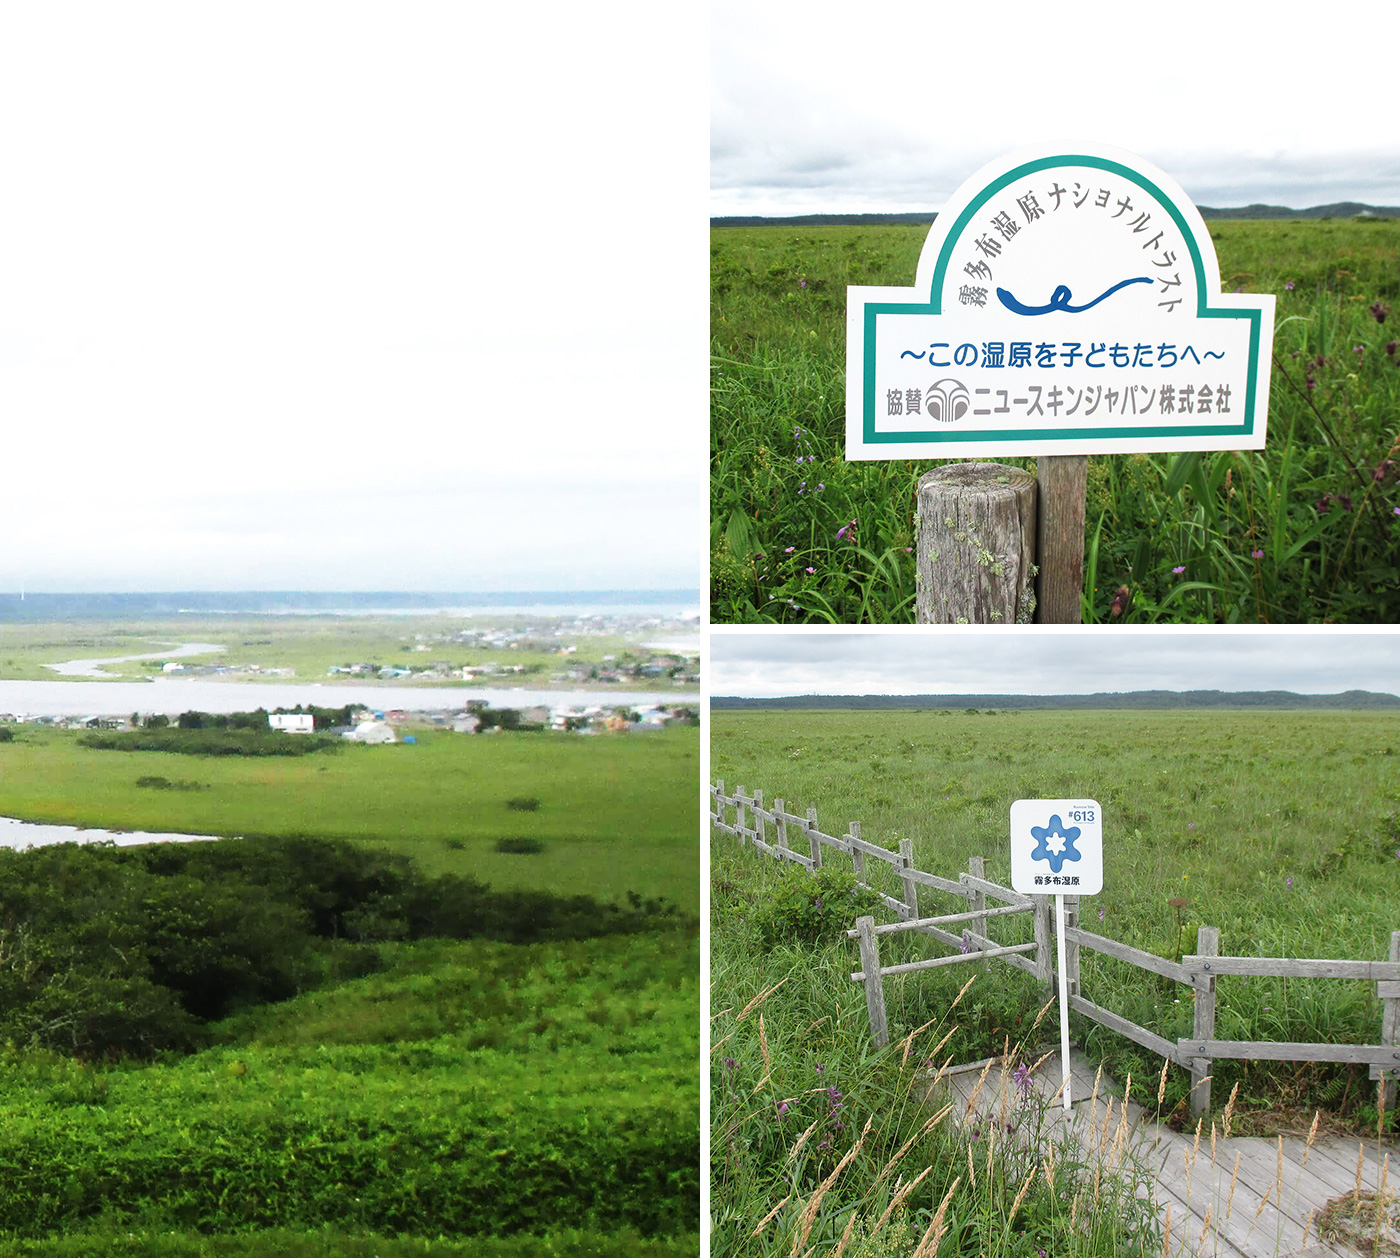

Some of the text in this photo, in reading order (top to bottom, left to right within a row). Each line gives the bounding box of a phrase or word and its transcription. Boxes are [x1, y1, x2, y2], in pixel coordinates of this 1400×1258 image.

[959, 182, 1183, 313] 霧多布湿原ナショナルトラスト
[886, 383, 1232, 417] 協賛 ニュースキンジャパン株式会社
[1068, 810, 1095, 821] #613
[1034, 875, 1080, 885] 霧多布湿原
